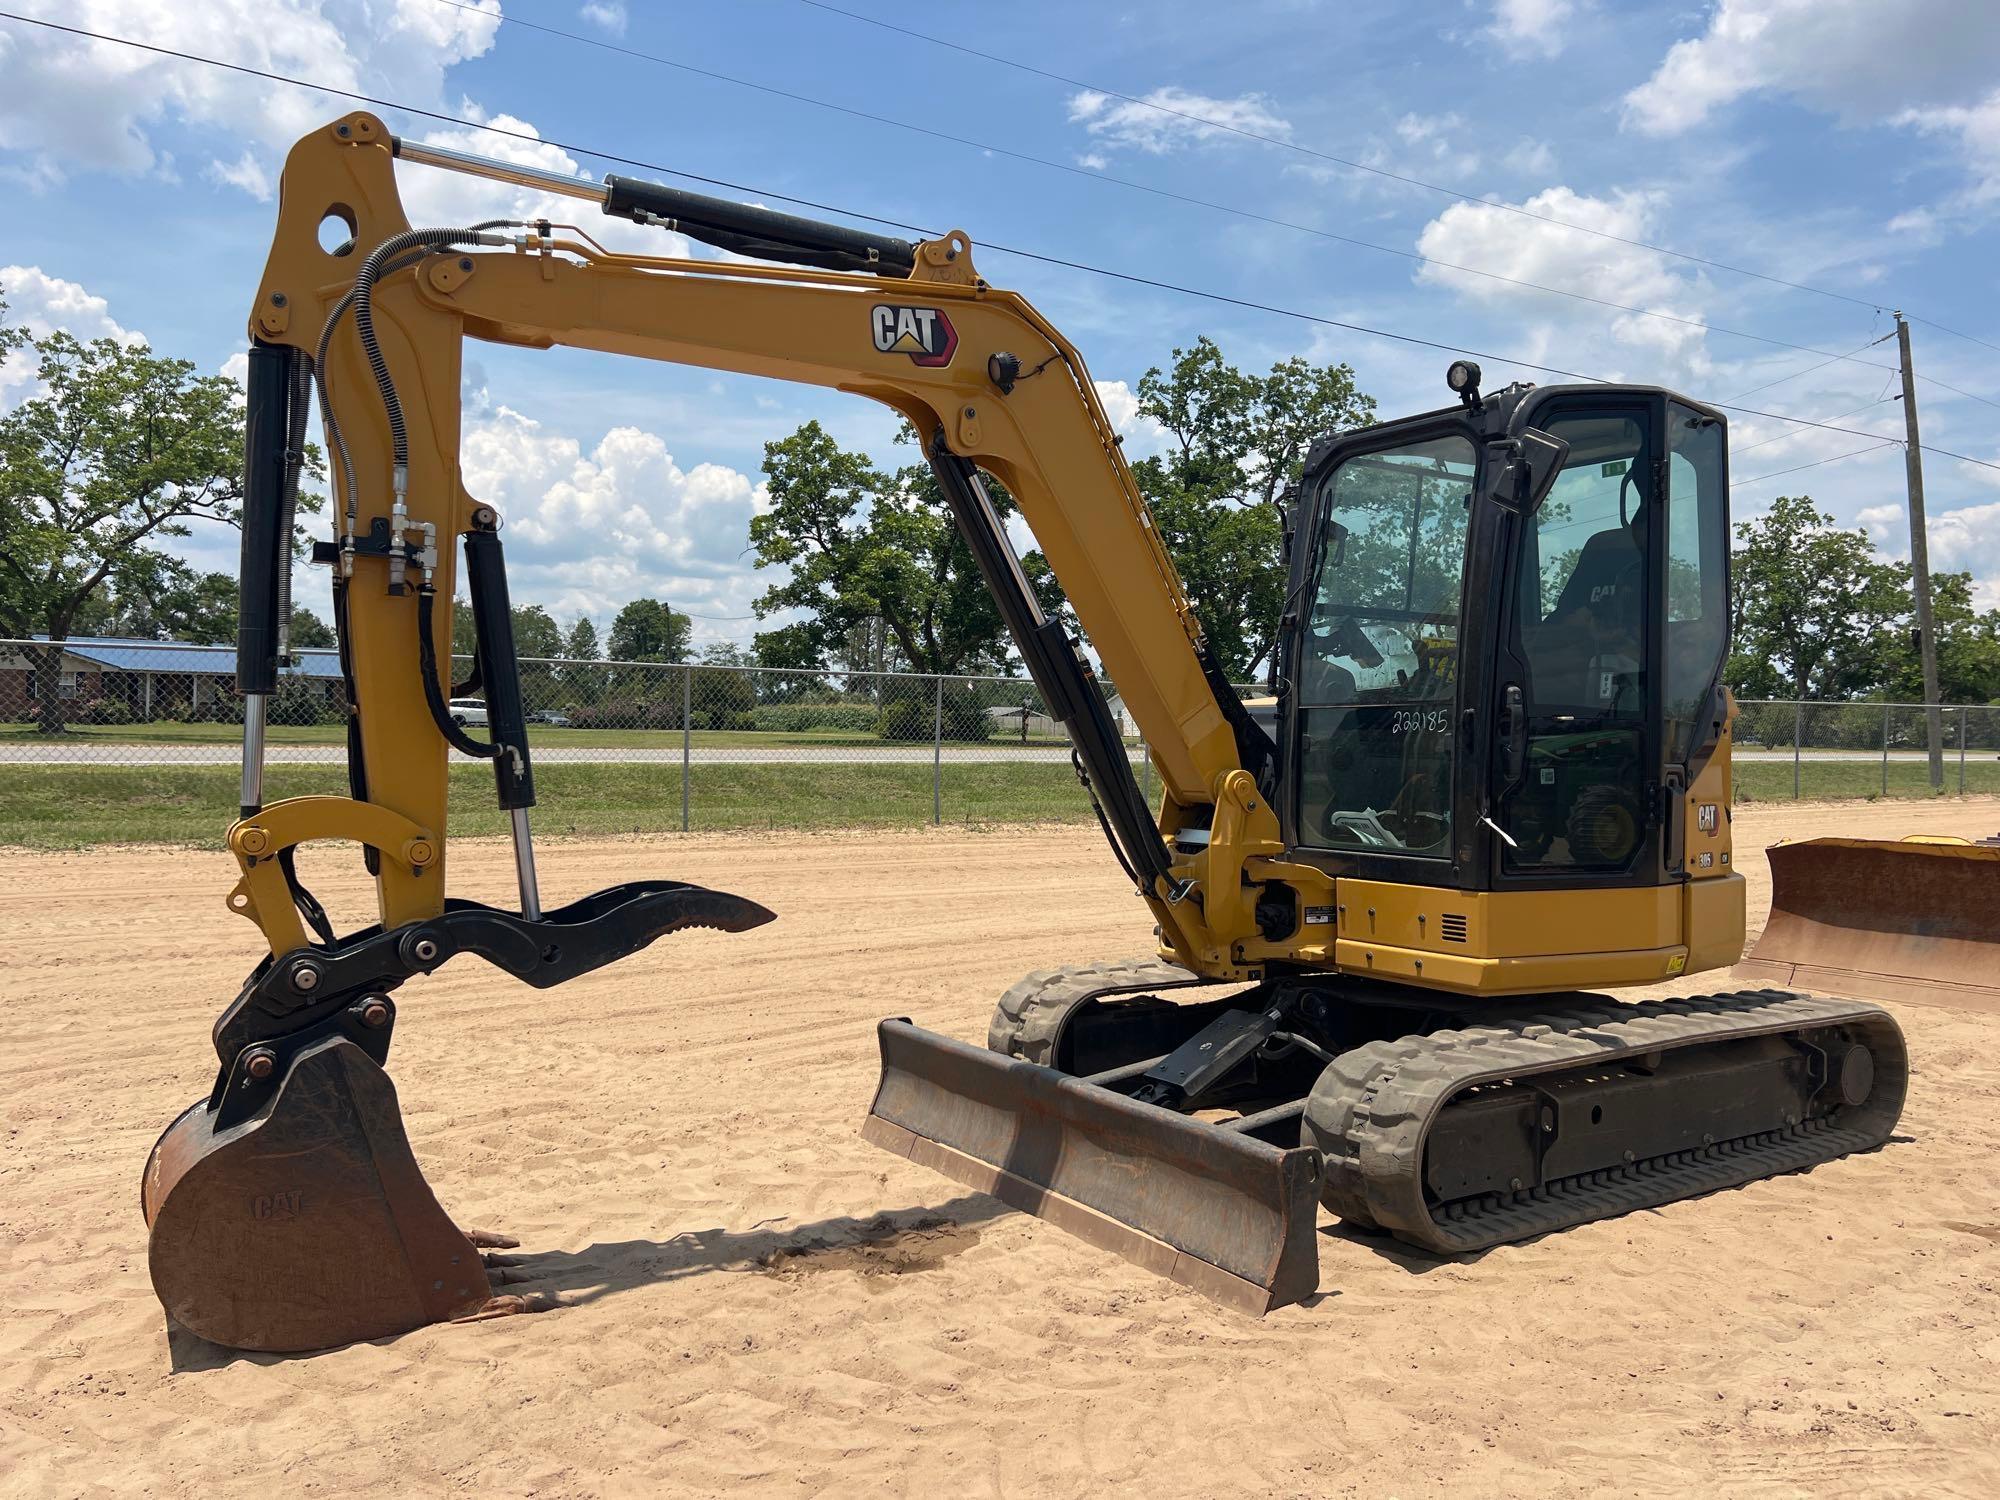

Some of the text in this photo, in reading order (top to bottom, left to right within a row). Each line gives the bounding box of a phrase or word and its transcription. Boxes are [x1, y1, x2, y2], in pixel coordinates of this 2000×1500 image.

[872, 305, 936, 353] CAT
[1590, 584, 1616, 602] CAT
[1392, 709, 1448, 734] 222185
[1698, 805, 1716, 830] CAT
[253, 1190, 303, 1219] CAT
